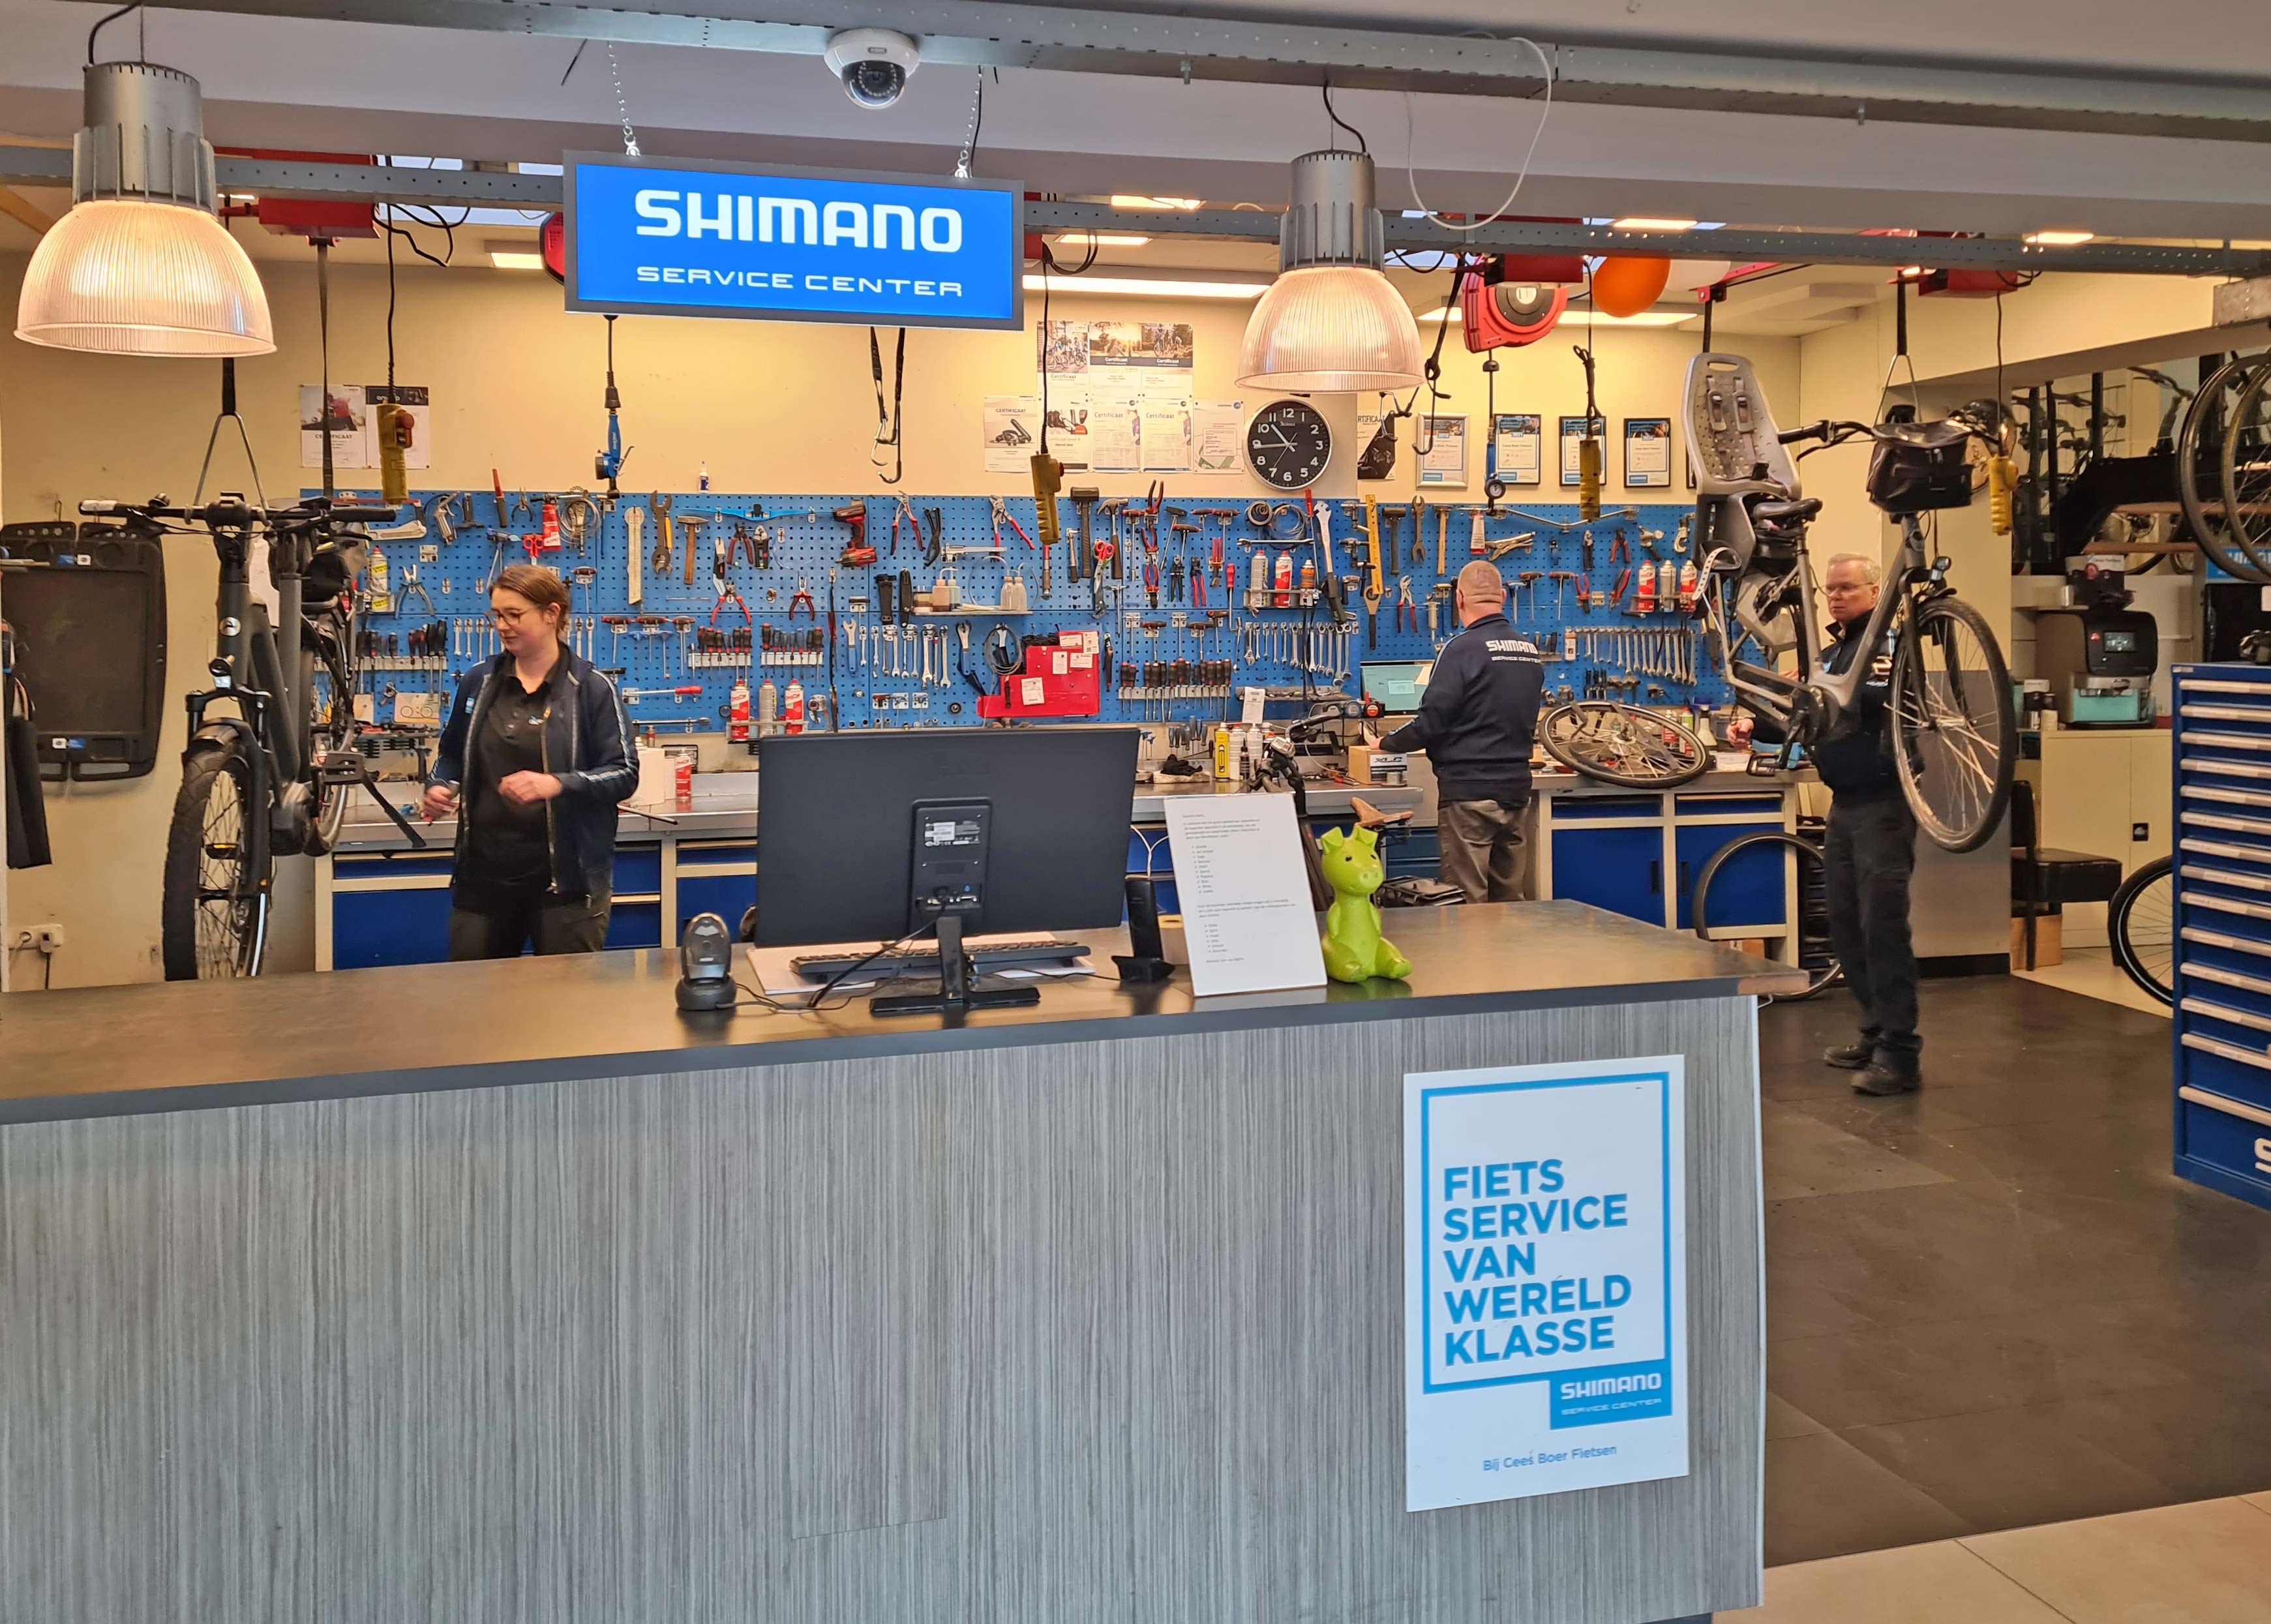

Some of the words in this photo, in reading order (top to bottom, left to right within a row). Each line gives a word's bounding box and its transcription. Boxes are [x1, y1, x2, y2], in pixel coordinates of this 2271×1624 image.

[635, 189, 963, 252] SHIMANO
[637, 266, 793, 288] SERVICE
[805, 275, 962, 297] CENTER
[1269, 412, 1276, 422] 11
[1283, 408, 1295, 418] 12
[1301, 412, 1304, 422] 1
[1257, 423, 1270, 433] 10
[1310, 425, 1319, 434] 2
[1252, 439, 1261, 449] 9
[1316, 440, 1323, 450] 3
[1257, 456, 1266, 466] 8
[1310, 457, 1319, 466] 4
[1269, 468, 1277, 477] 7
[1283, 472, 1292, 481] 6
[1300, 468, 1308, 477] 5
[1485, 639, 1539, 655] SHIMANO
[1443, 1158, 1565, 1202] FIETS
[1443, 1194, 1628, 1243] SERVICE
[1443, 1242, 1536, 1284] VAN
[1444, 1274, 1632, 1325] WERELD
[1445, 1316, 1616, 1367] KLASSE
[1561, 1372, 1662, 1400] SHIMANO
[1561, 1404, 1610, 1415] SERVICE
[1611, 1398, 1662, 1409] CENTER
[1483, 1458, 1499, 1471] Bij
[1503, 1456, 1534, 1469] Cees
[1538, 1452, 1567, 1464] Boer
[1571, 1446, 1617, 1460] Fietsen
